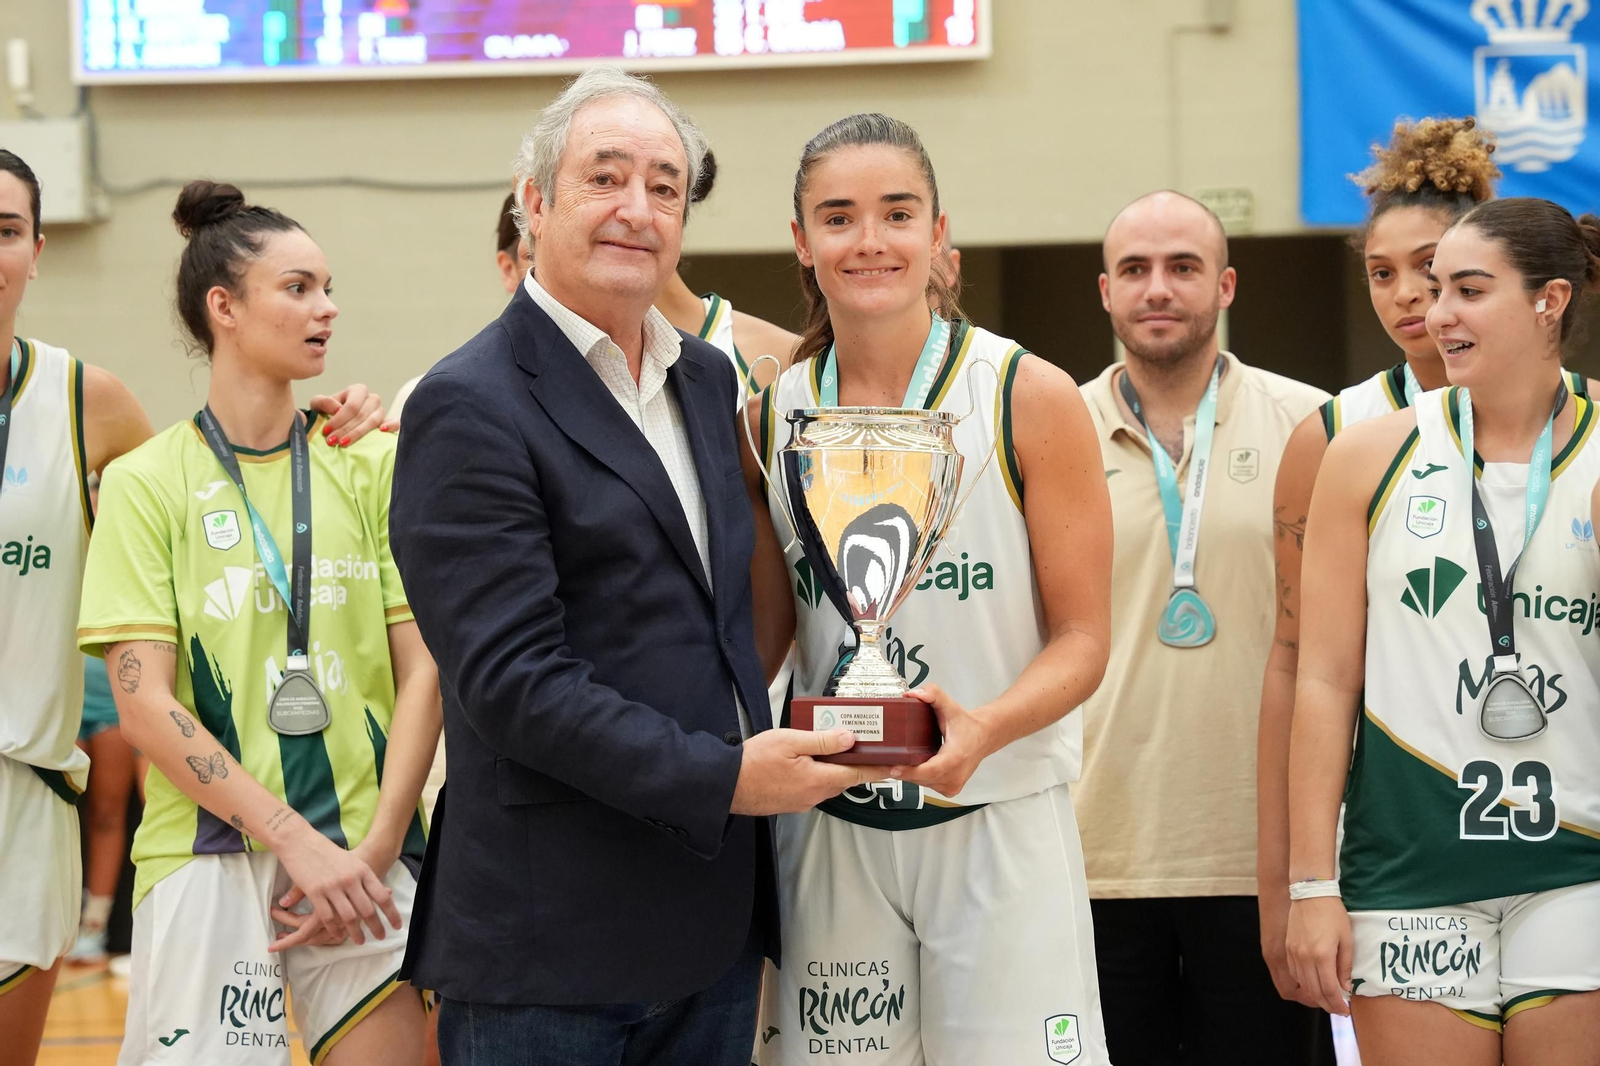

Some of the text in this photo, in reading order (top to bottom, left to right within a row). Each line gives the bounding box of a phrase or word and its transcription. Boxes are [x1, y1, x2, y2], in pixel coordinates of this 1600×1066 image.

[0, 535, 51, 576] aja
[853, 712, 880, 720] ANDALUCÍA
[1458, 757, 1560, 841] 23
[1388, 917, 1468, 931] CLINICAS
[234, 961, 281, 978] CLINIC
[807, 960, 889, 977] CLINICAS
[1390, 986, 1466, 1000] DENTAL
[226, 1031, 290, 1047] DENTA
[809, 1036, 890, 1054] DENTAL
